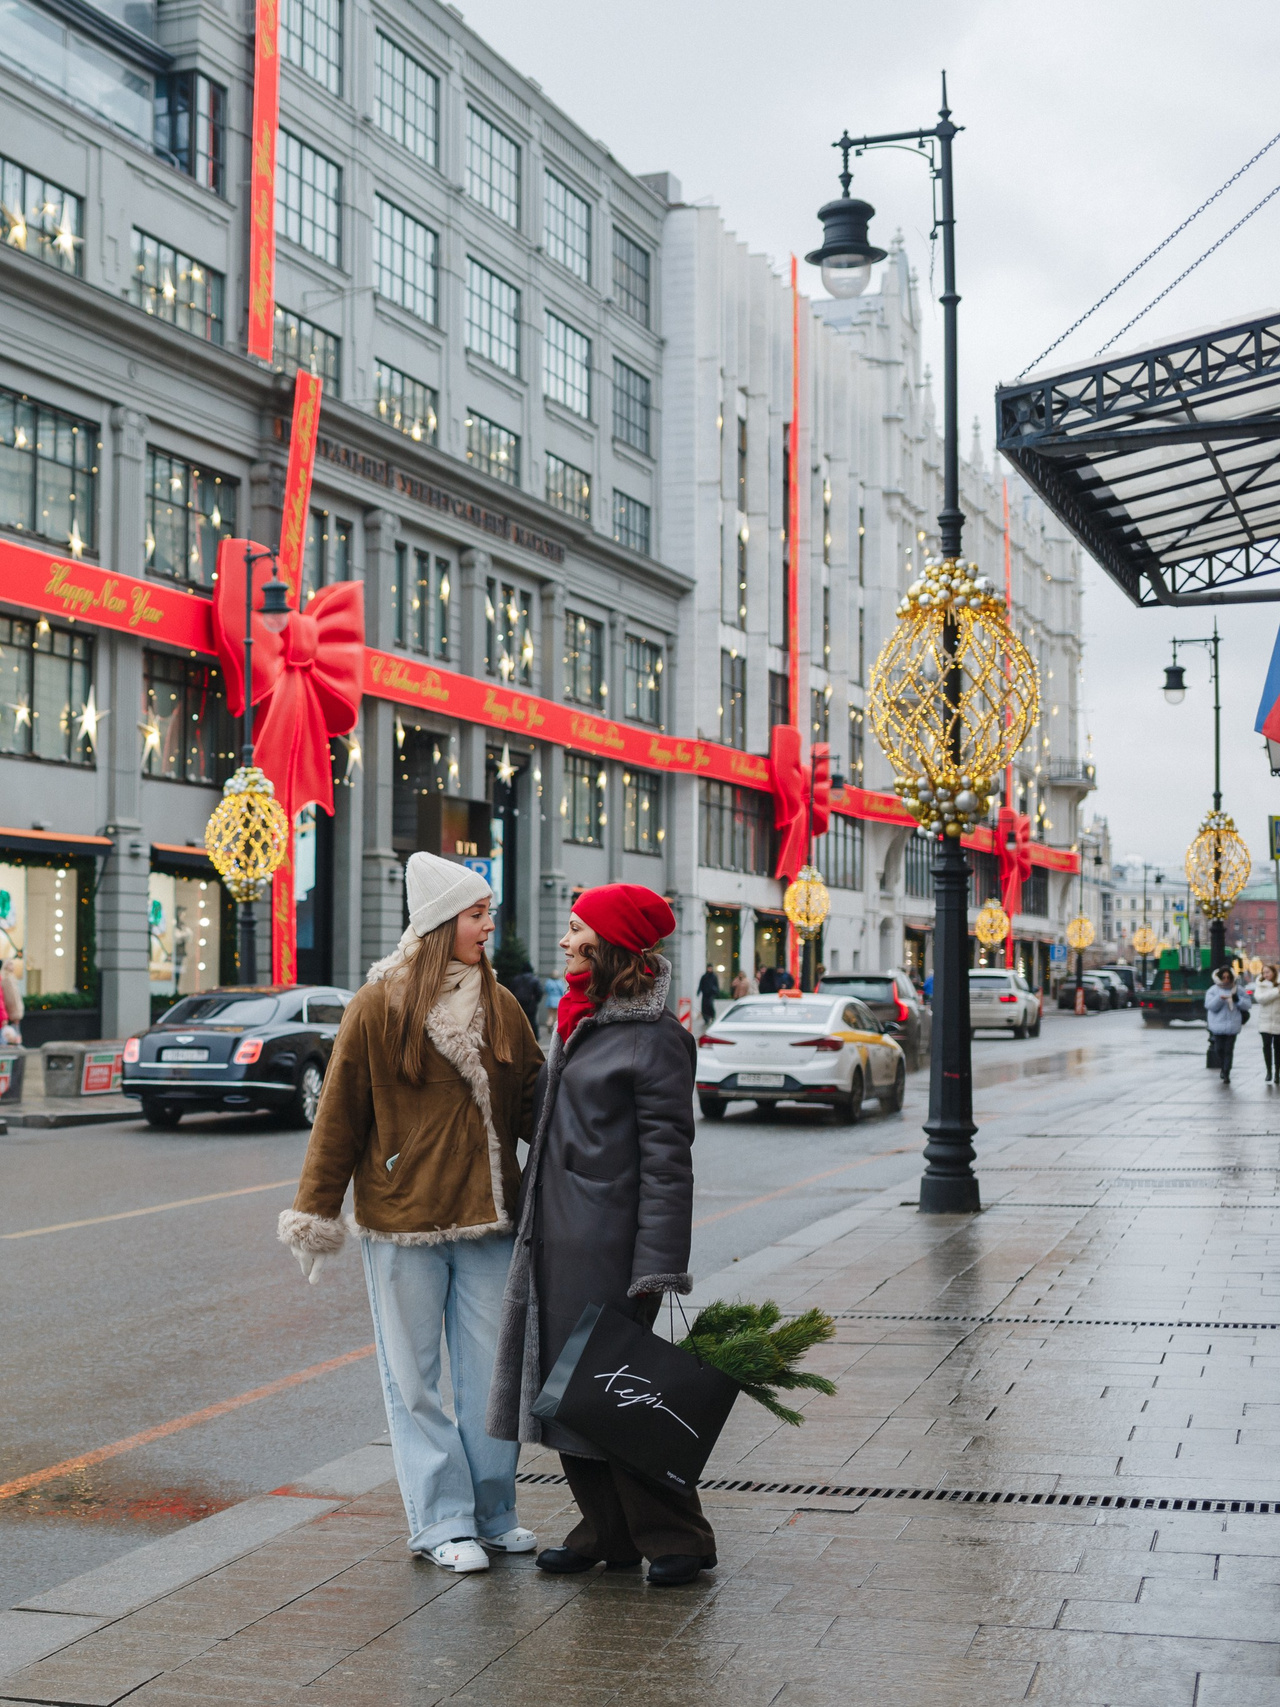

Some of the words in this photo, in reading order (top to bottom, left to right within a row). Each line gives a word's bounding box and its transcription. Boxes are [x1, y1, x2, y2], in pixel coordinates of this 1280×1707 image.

[45, 562, 95, 613] Happy
[92, 578, 127, 613] New
[129, 586, 164, 627] Year
